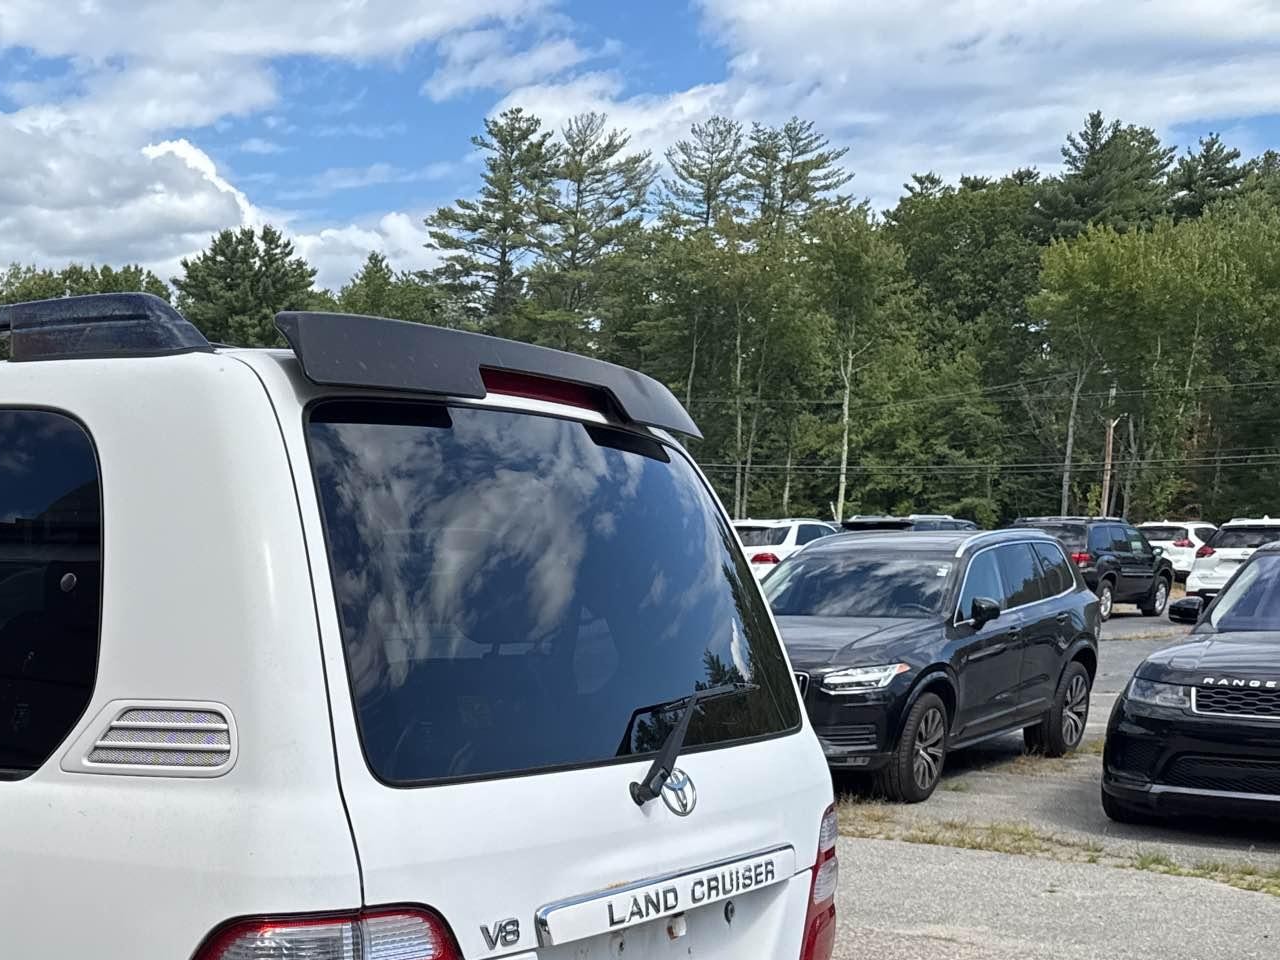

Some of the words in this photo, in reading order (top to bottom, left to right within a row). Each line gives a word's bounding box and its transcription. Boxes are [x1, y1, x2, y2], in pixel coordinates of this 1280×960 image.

[1203, 678, 1277, 687] RANGE
[608, 888, 678, 927] LAND
[691, 860, 774, 904] CRUISER
[479, 917, 521, 950] V8
